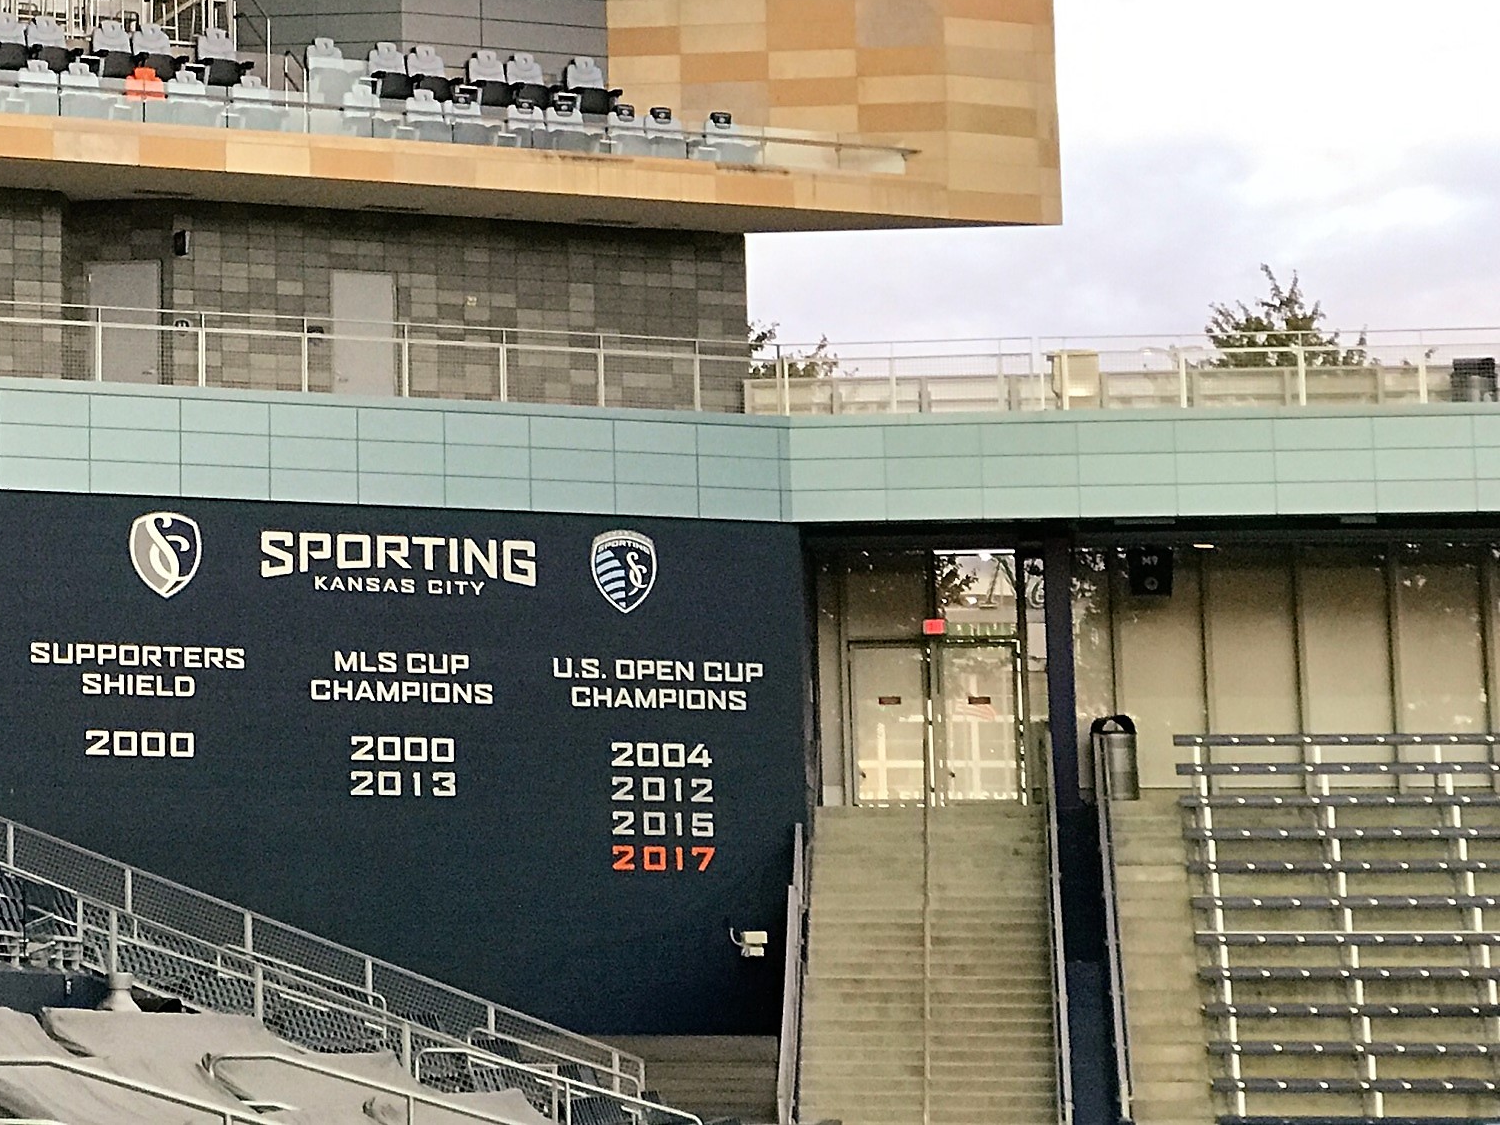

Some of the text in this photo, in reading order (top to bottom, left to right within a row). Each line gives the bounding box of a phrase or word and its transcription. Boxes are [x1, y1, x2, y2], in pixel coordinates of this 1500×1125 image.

[260, 530, 537, 587] SPORTING
[597, 539, 651, 556] SPORTING
[314, 575, 485, 596] KANSAS CITY
[30, 641, 245, 670] SUPPORTERS
[334, 650, 470, 675] MLS CUP
[552, 656, 764, 683] U.S. OPEN CUP
[82, 673, 196, 697] SHIELD
[310, 679, 494, 705] CHAMPIONS
[571, 686, 747, 711] CHAMPIONS
[85, 729, 195, 758] 2000
[350, 735, 455, 763] 2000
[611, 741, 713, 768] 2004
[350, 770, 457, 797] 2013
[611, 776, 714, 803] 2012
[611, 810, 714, 837] 2015
[612, 843, 716, 872] 2017
